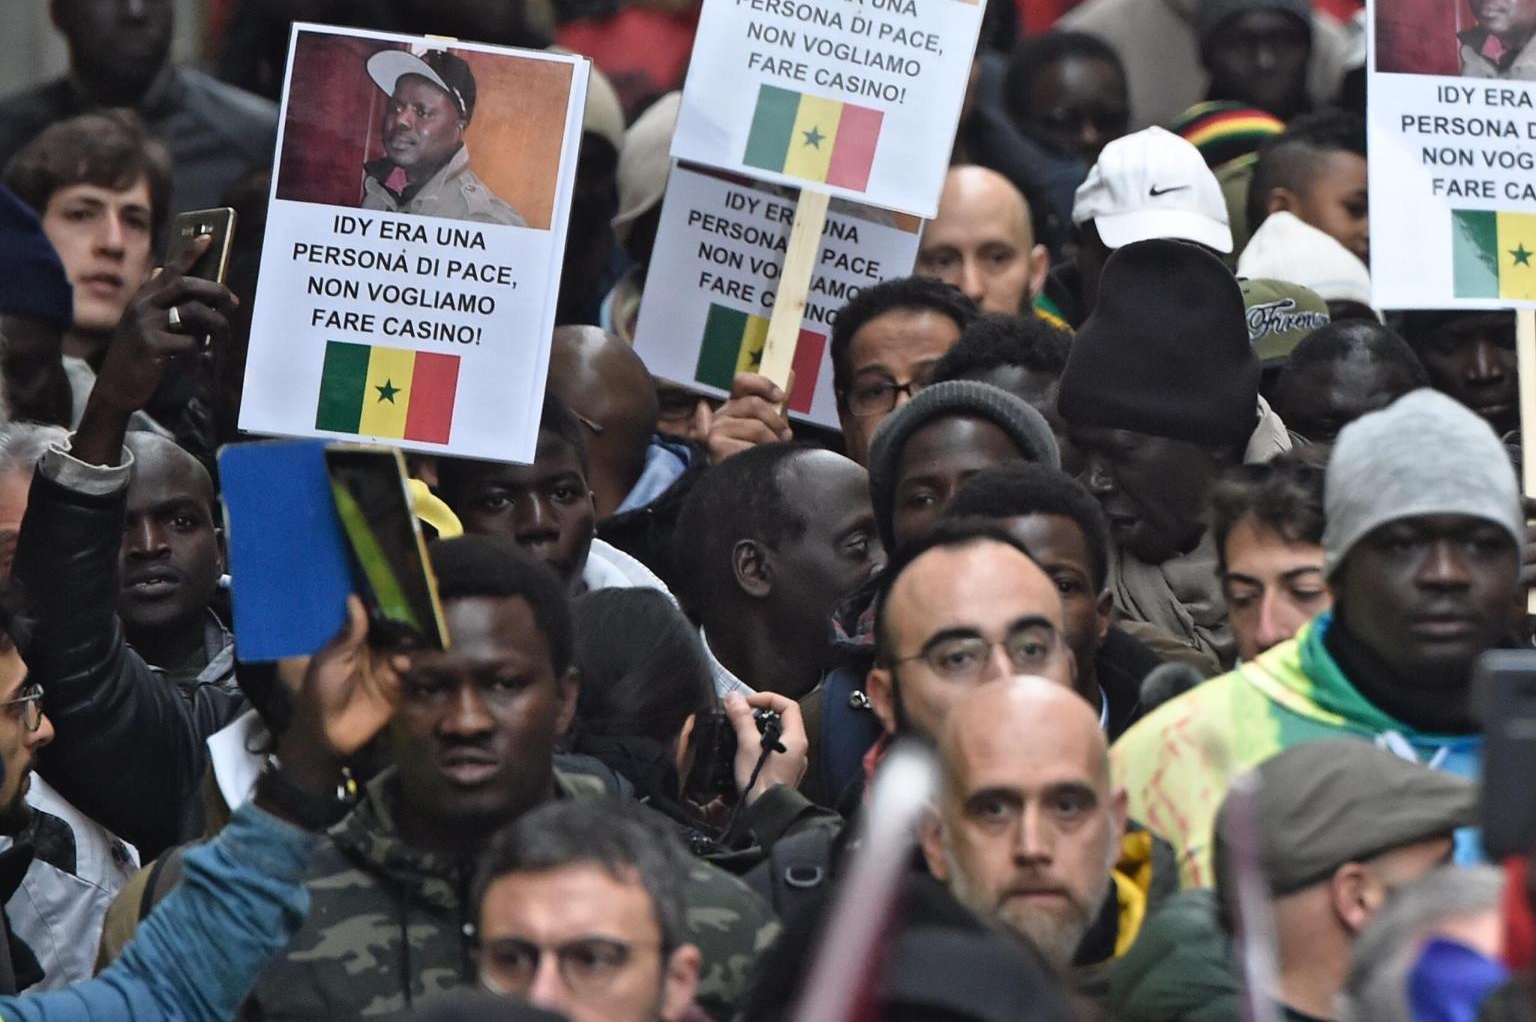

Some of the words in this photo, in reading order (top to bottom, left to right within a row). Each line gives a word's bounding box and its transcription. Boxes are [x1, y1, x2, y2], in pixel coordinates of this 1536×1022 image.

[747, 22, 795, 48] NON
[803, 35, 920, 77] VOGLIAMO
[851, 17, 873, 36] DI
[879, 23, 943, 56] PACE,
[748, 52, 808, 81] FARE
[815, 69, 906, 104] CASINO!
[1438, 86, 1475, 105] IDY
[1485, 89, 1532, 108] ERA
[1401, 115, 1519, 138] PERSONA
[1422, 147, 1473, 166] NON
[1432, 179, 1496, 198] FARE
[725, 192, 761, 214] IDY
[765, 203, 795, 226] ER
[334, 215, 373, 236] IDY
[380, 221, 428, 243] ERA
[437, 227, 486, 250] UNA
[688, 210, 788, 253] PERSONA
[821, 249, 883, 283] PACE,
[293, 243, 408, 273] PERSONA
[417, 257, 439, 276] DI
[447, 261, 517, 289] PACE,
[699, 242, 743, 268] NON
[308, 276, 359, 299] NON
[368, 283, 495, 314] VOGLIAMO
[699, 272, 755, 303] FARE
[761, 291, 839, 326] CINO
[312, 309, 375, 333] FARE
[383, 318, 482, 345] CASINO!
